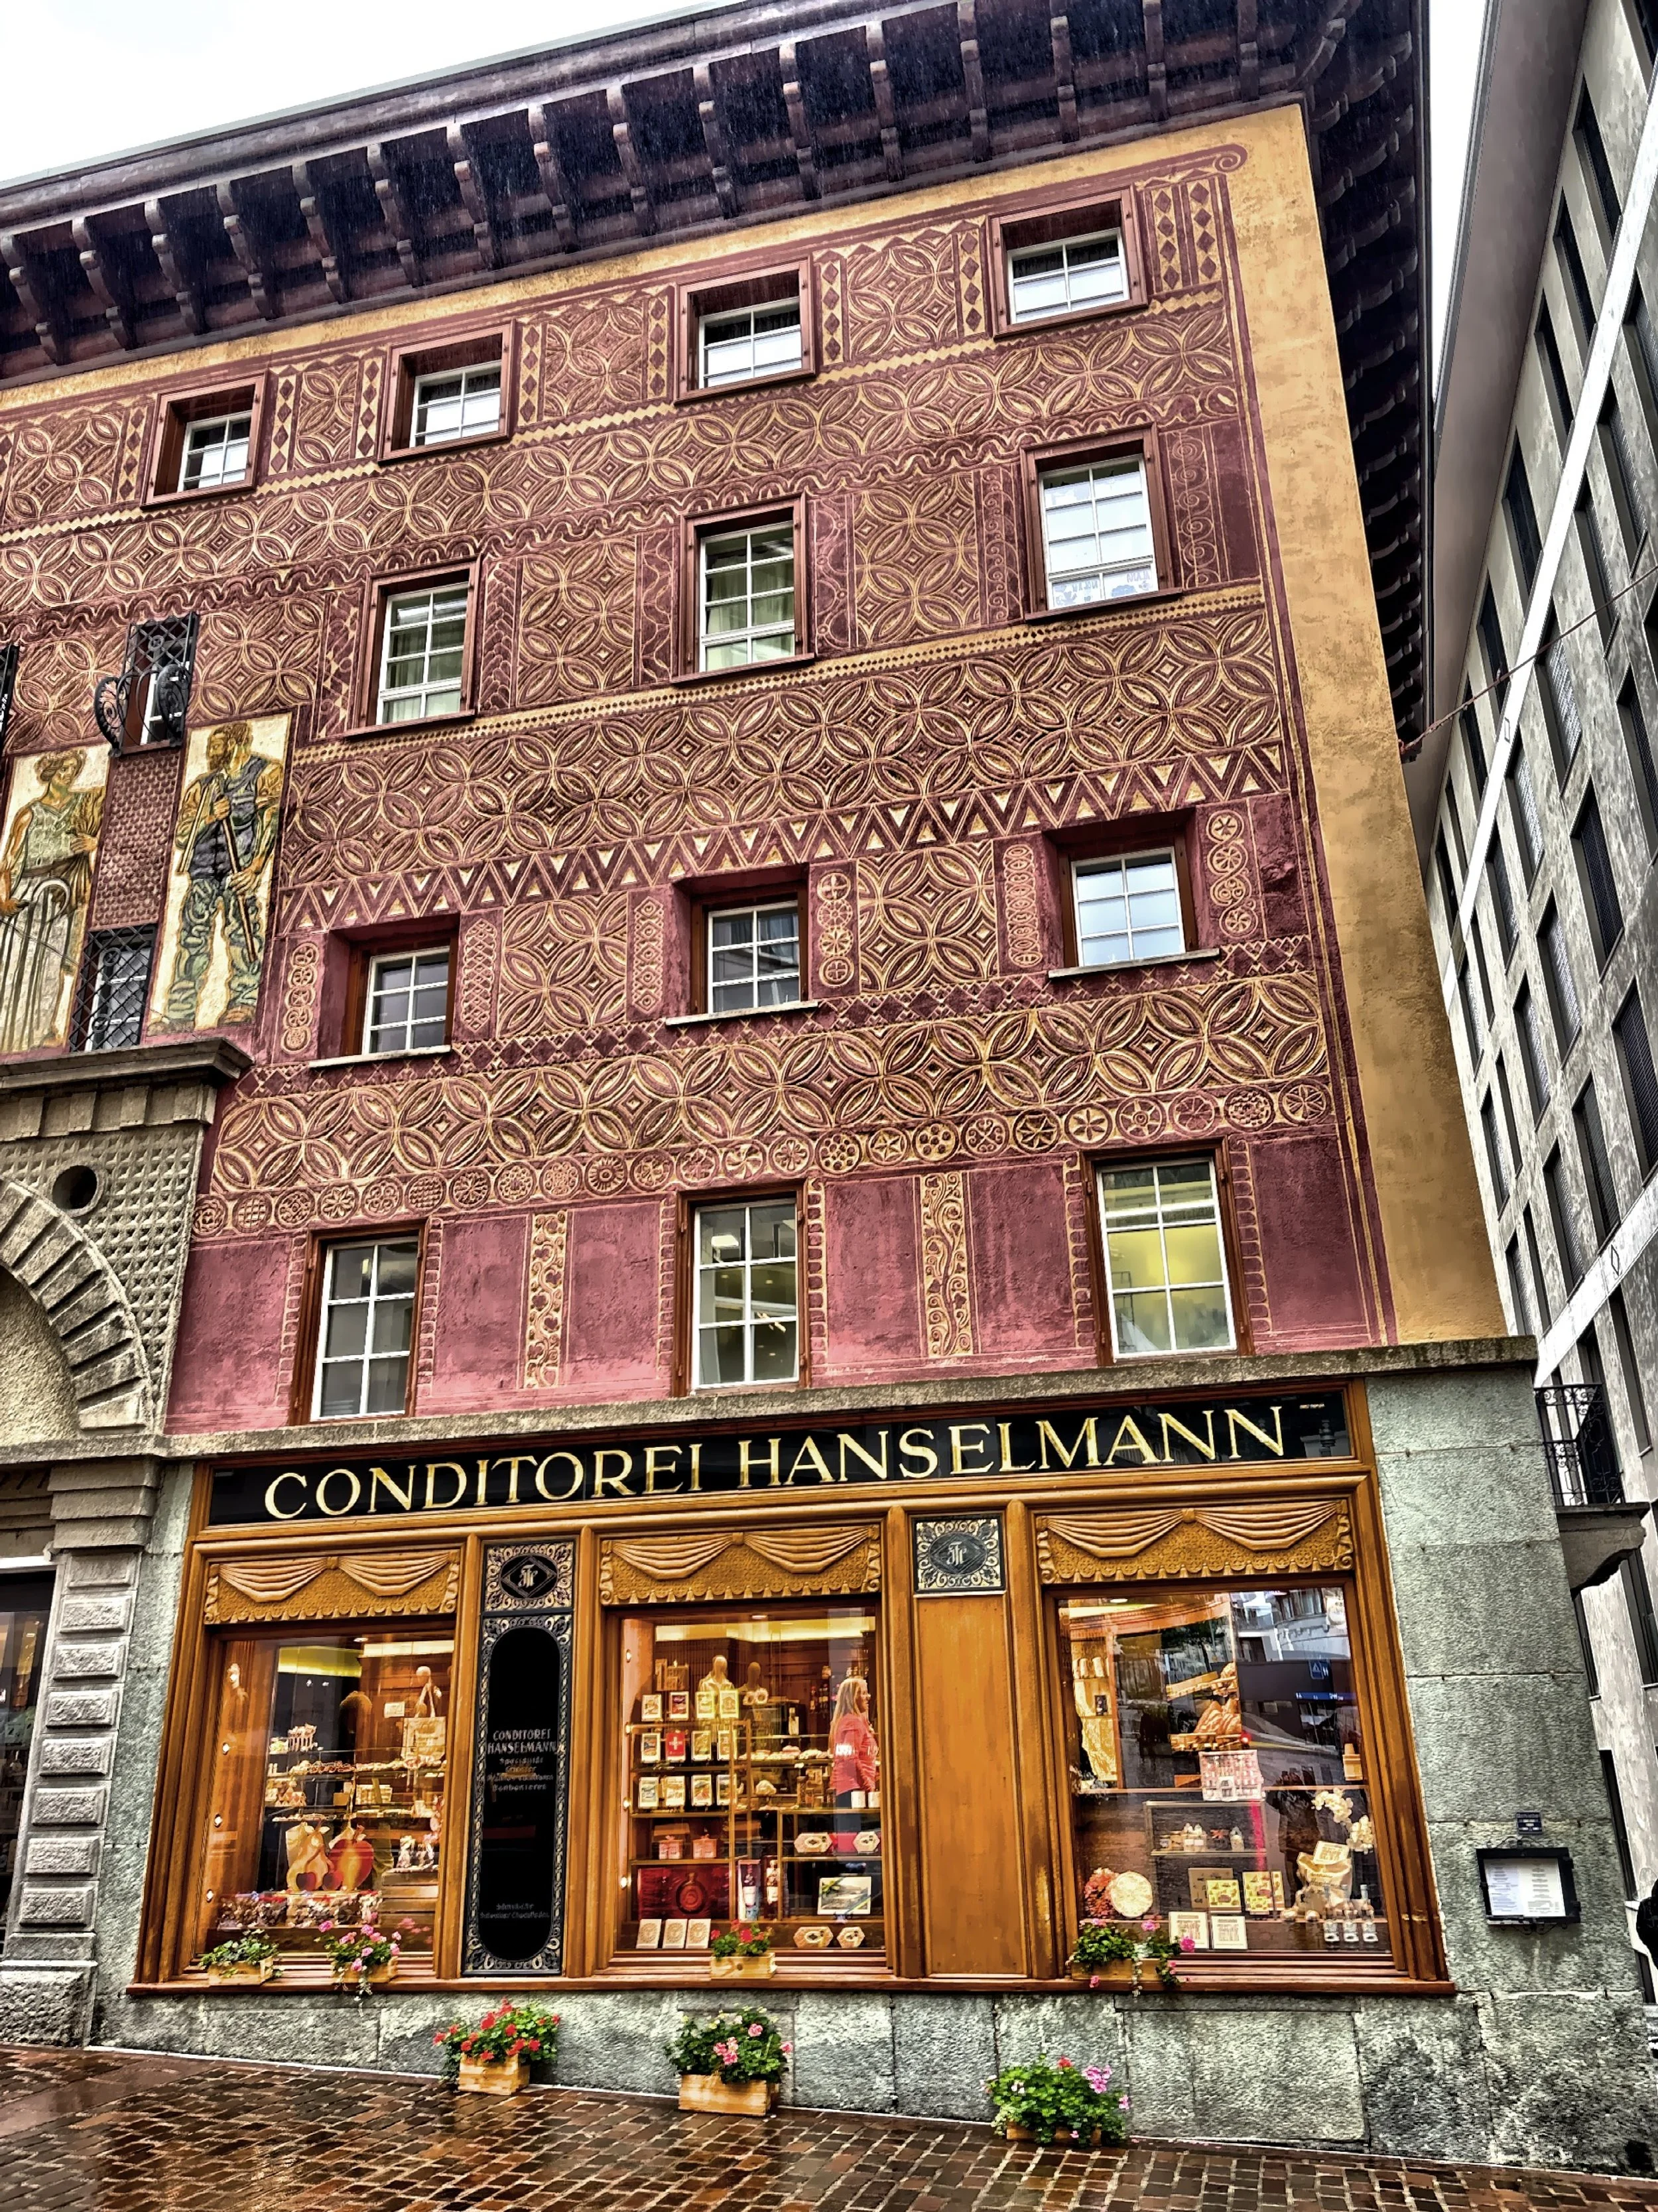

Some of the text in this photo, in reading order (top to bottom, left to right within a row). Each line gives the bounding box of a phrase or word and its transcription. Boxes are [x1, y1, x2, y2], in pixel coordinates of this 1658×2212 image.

[264, 1405, 1284, 1519] CONDITOREI HANSELMANN
[493, 1728, 551, 1742] CONDITOREI
[487, 1740, 557, 1755] HANSELMANN
